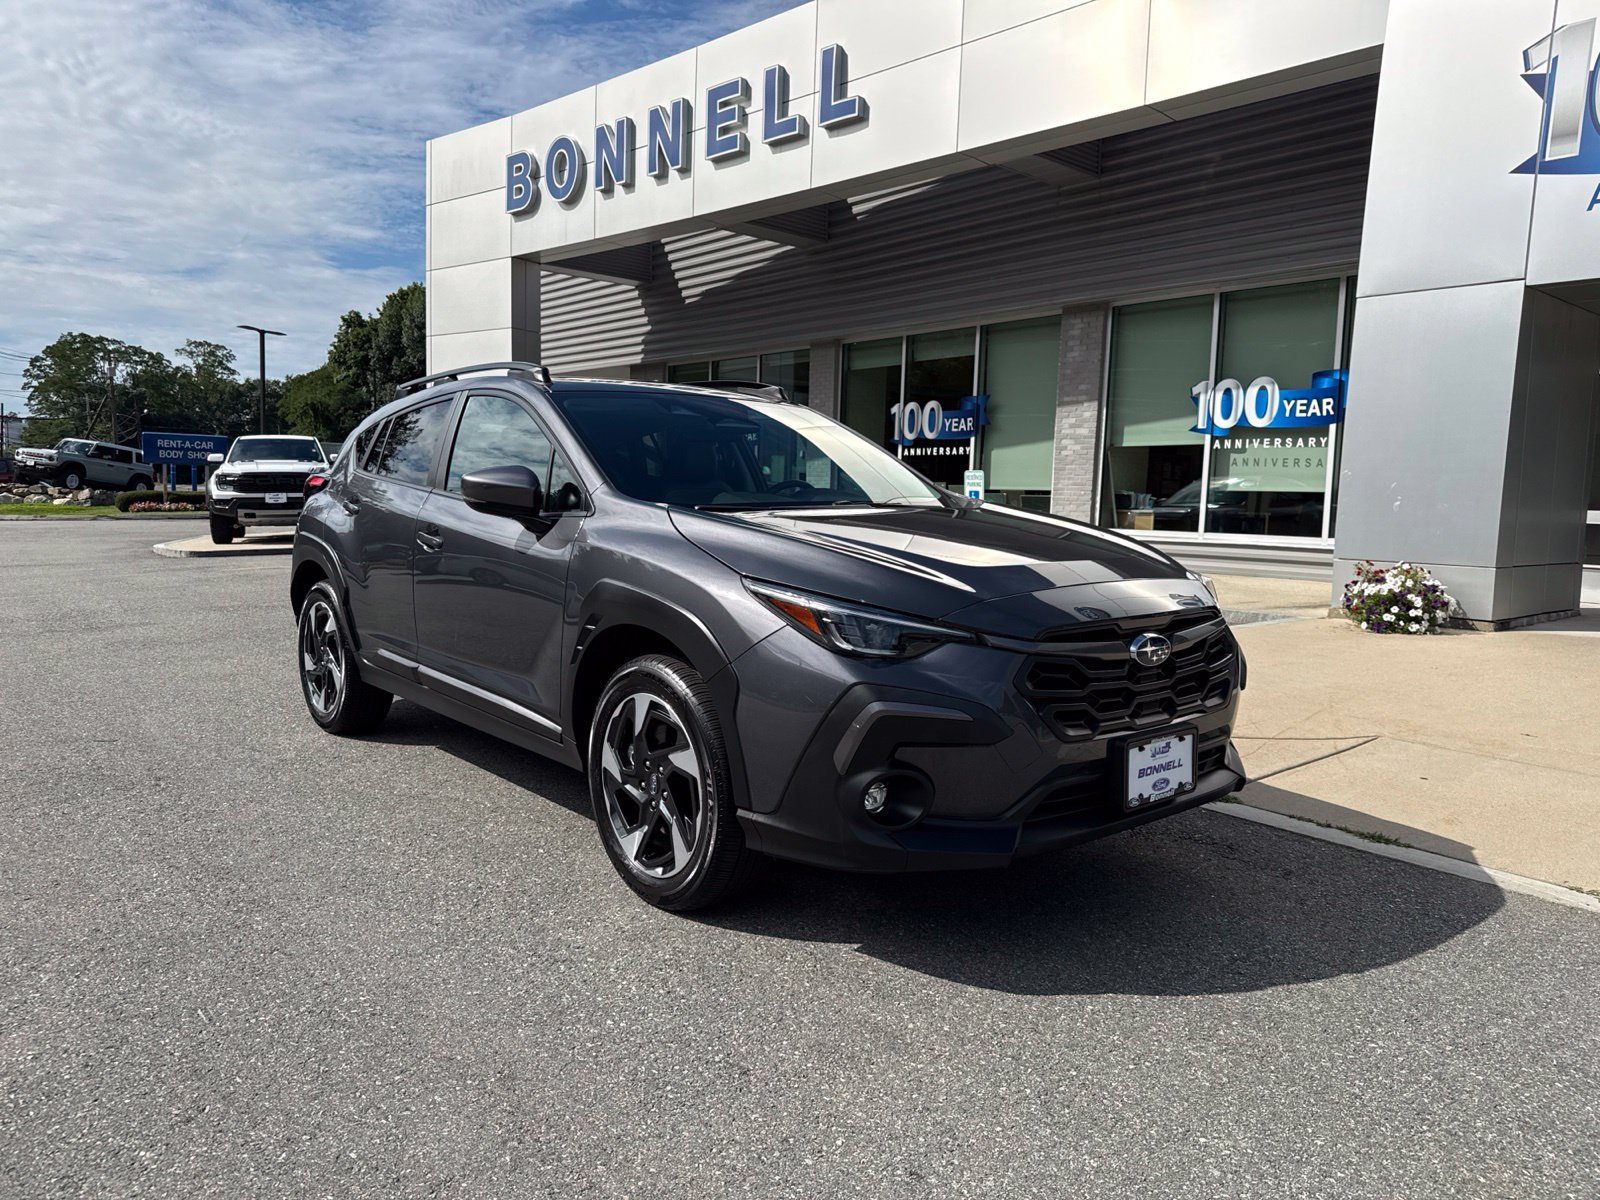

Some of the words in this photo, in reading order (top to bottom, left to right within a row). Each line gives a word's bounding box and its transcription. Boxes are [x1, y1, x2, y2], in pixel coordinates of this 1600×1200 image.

[505, 43, 867, 214] BONNELL
[1191, 376, 1280, 430] 100
[1282, 397, 1335, 417] YEAR
[890, 400, 943, 440] 100
[944, 417, 974, 432] YEAR
[157, 439, 214, 450] RENT-A-CAR
[903, 446, 971, 456] ANNIVERSARY
[1213, 436, 1328, 450] ANNIVERSARY
[159, 449, 184, 459] BODY
[1137, 758, 1183, 779] BONNELL
